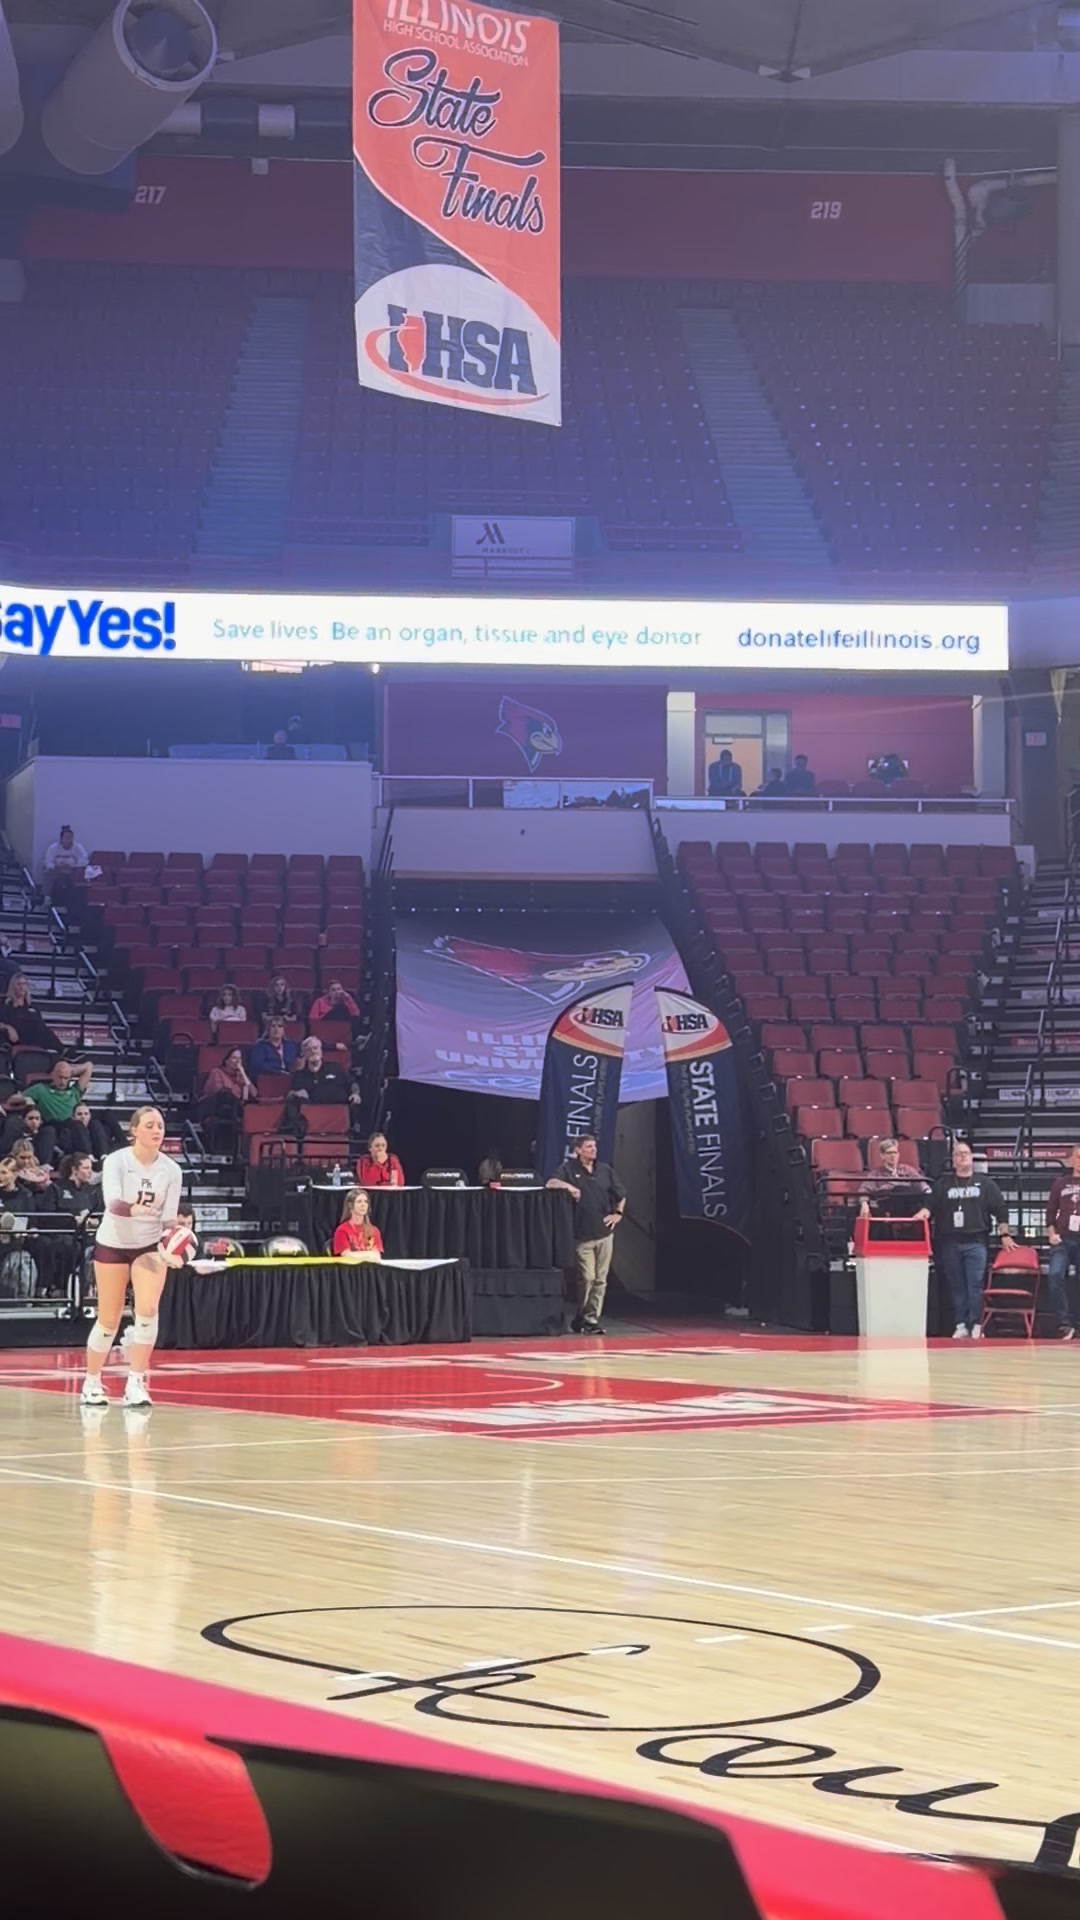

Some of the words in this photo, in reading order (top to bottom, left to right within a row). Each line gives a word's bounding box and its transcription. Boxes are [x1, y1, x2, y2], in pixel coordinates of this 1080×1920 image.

[383, 19, 413, 37] HIGH
[416, 26, 461, 49] SCHOOL
[464, 40, 529, 66] ASSOCIATION
[368, 48, 501, 138] State
[135, 185, 166, 205] 217
[412, 135, 546, 234] Finals
[811, 201, 842, 219] 219
[213, 618, 264, 639] Save
[270, 620, 318, 640] lives
[332, 621, 360, 641] Be
[366, 626, 391, 641] an
[399, 627, 468, 647] organ,
[475, 624, 538, 644] tissue
[544, 625, 585, 644] and
[592, 629, 629, 649] eye
[637, 626, 701, 645] donor
[565, 1054, 599, 1137] FINALS
[689, 1061, 719, 1127] STATE
[136, 1190, 156, 1207] 12
[696, 1133, 728, 1218] FINALS
